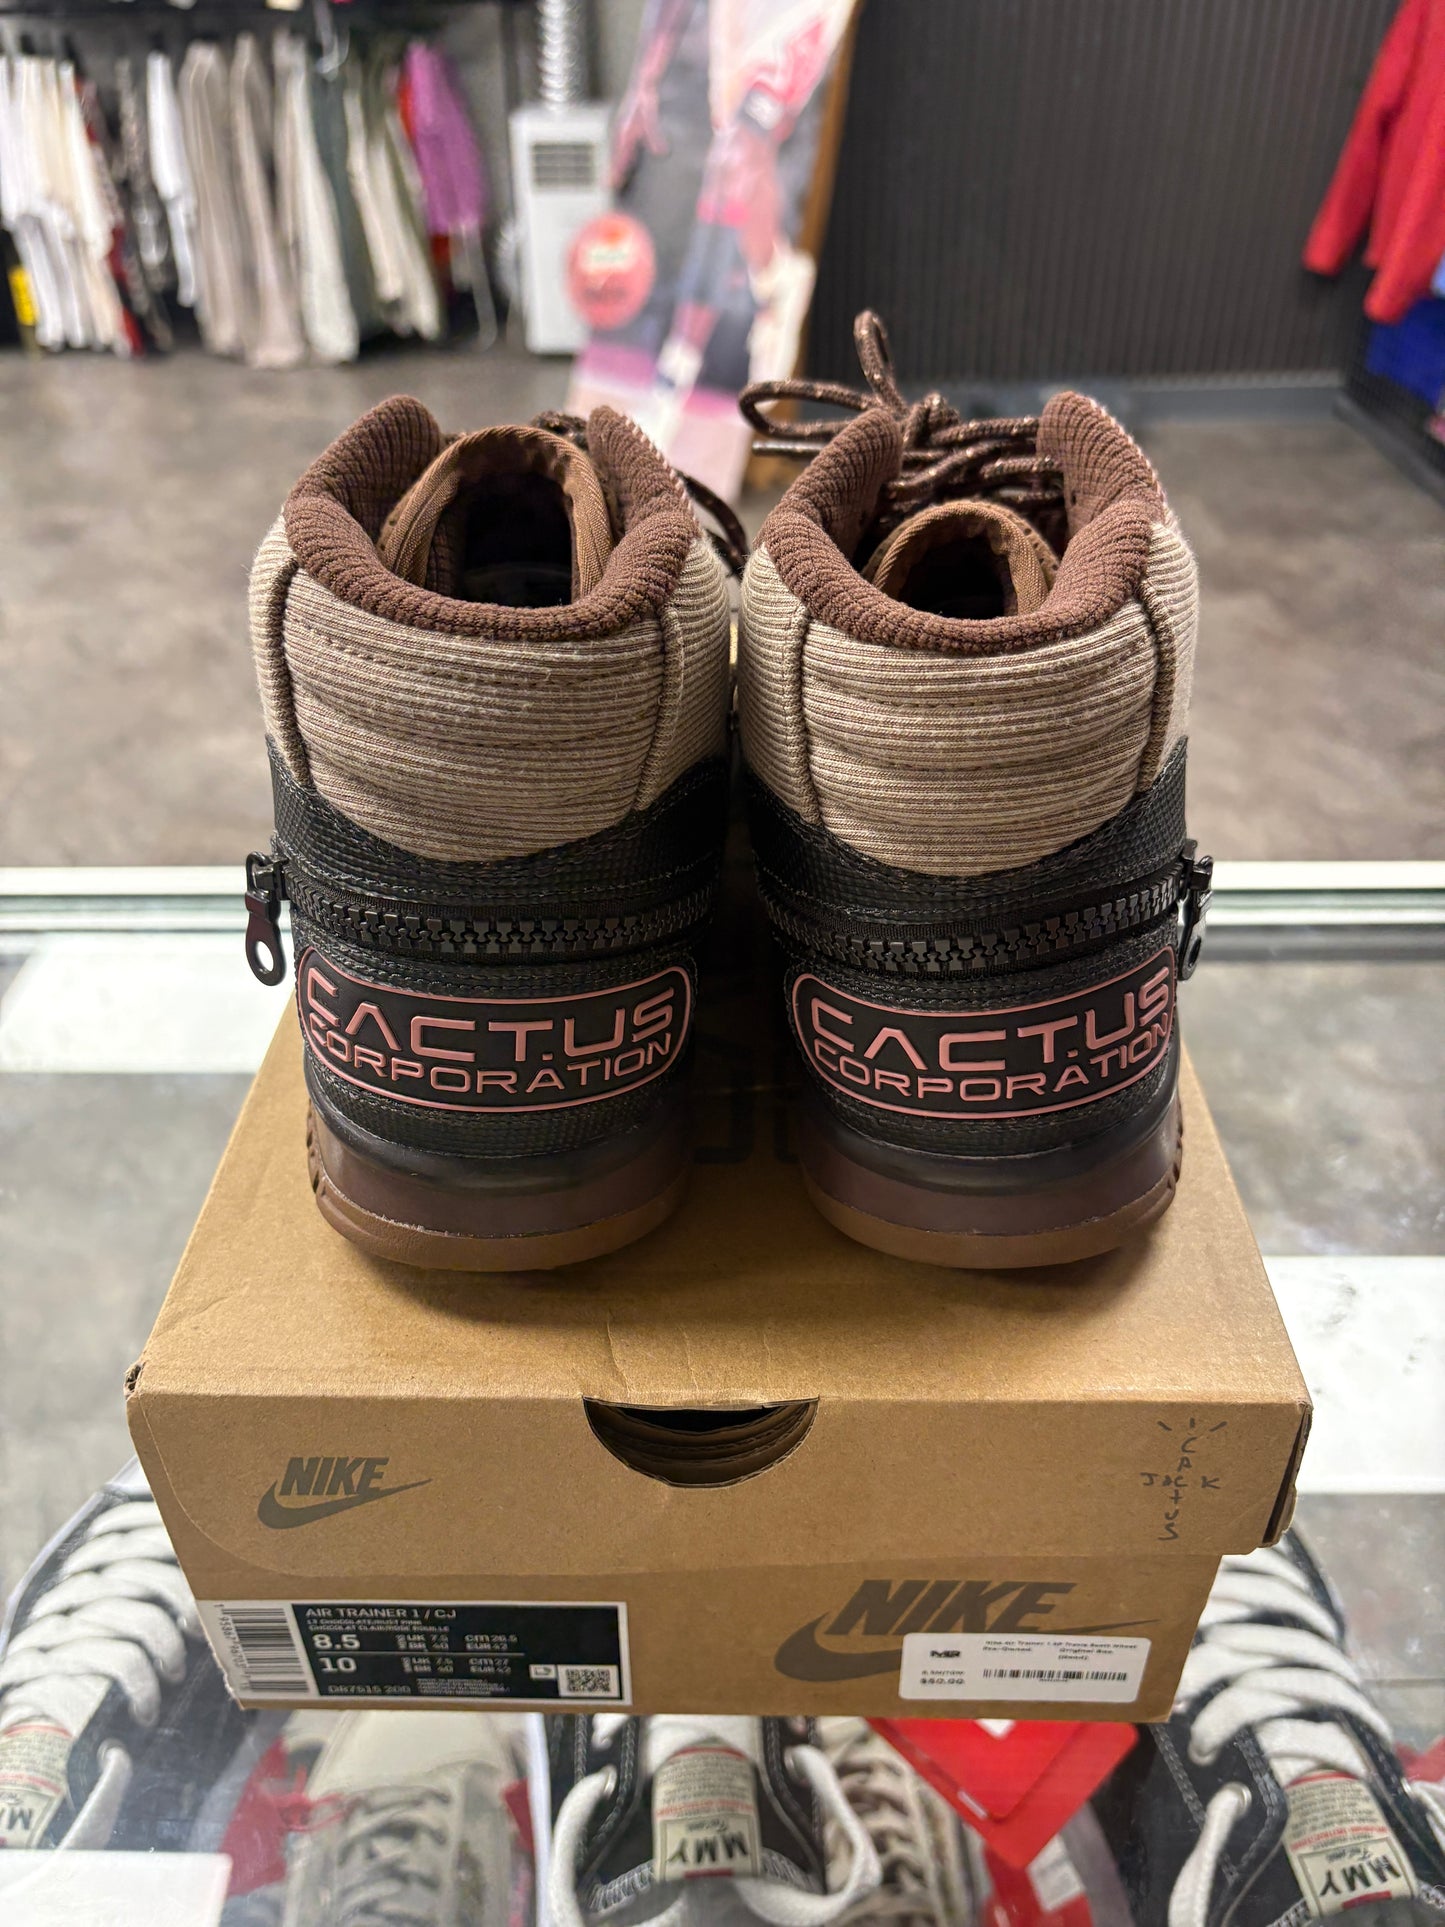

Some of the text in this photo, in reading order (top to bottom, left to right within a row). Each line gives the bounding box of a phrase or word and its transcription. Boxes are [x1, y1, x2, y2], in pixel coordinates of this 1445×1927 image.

[307, 967, 675, 1063] CACT.US
[810, 966, 1170, 1072] CACT.US
[308, 1012, 672, 1094] CORPORATION
[814, 1012, 1172, 1101] CORPORATION
[279, 1456, 390, 1497] NIKE
[305, 1607, 333, 1618] AIR
[335, 1608, 408, 1618] TRAINER
[412, 1608, 419, 1618] 1
[434, 1608, 457, 1618] CJ
[824, 1579, 1078, 1636] NIKE
[312, 1633, 361, 1650] 8.5
[464, 1634, 490, 1642] cm
[319, 1656, 358, 1673] 10
